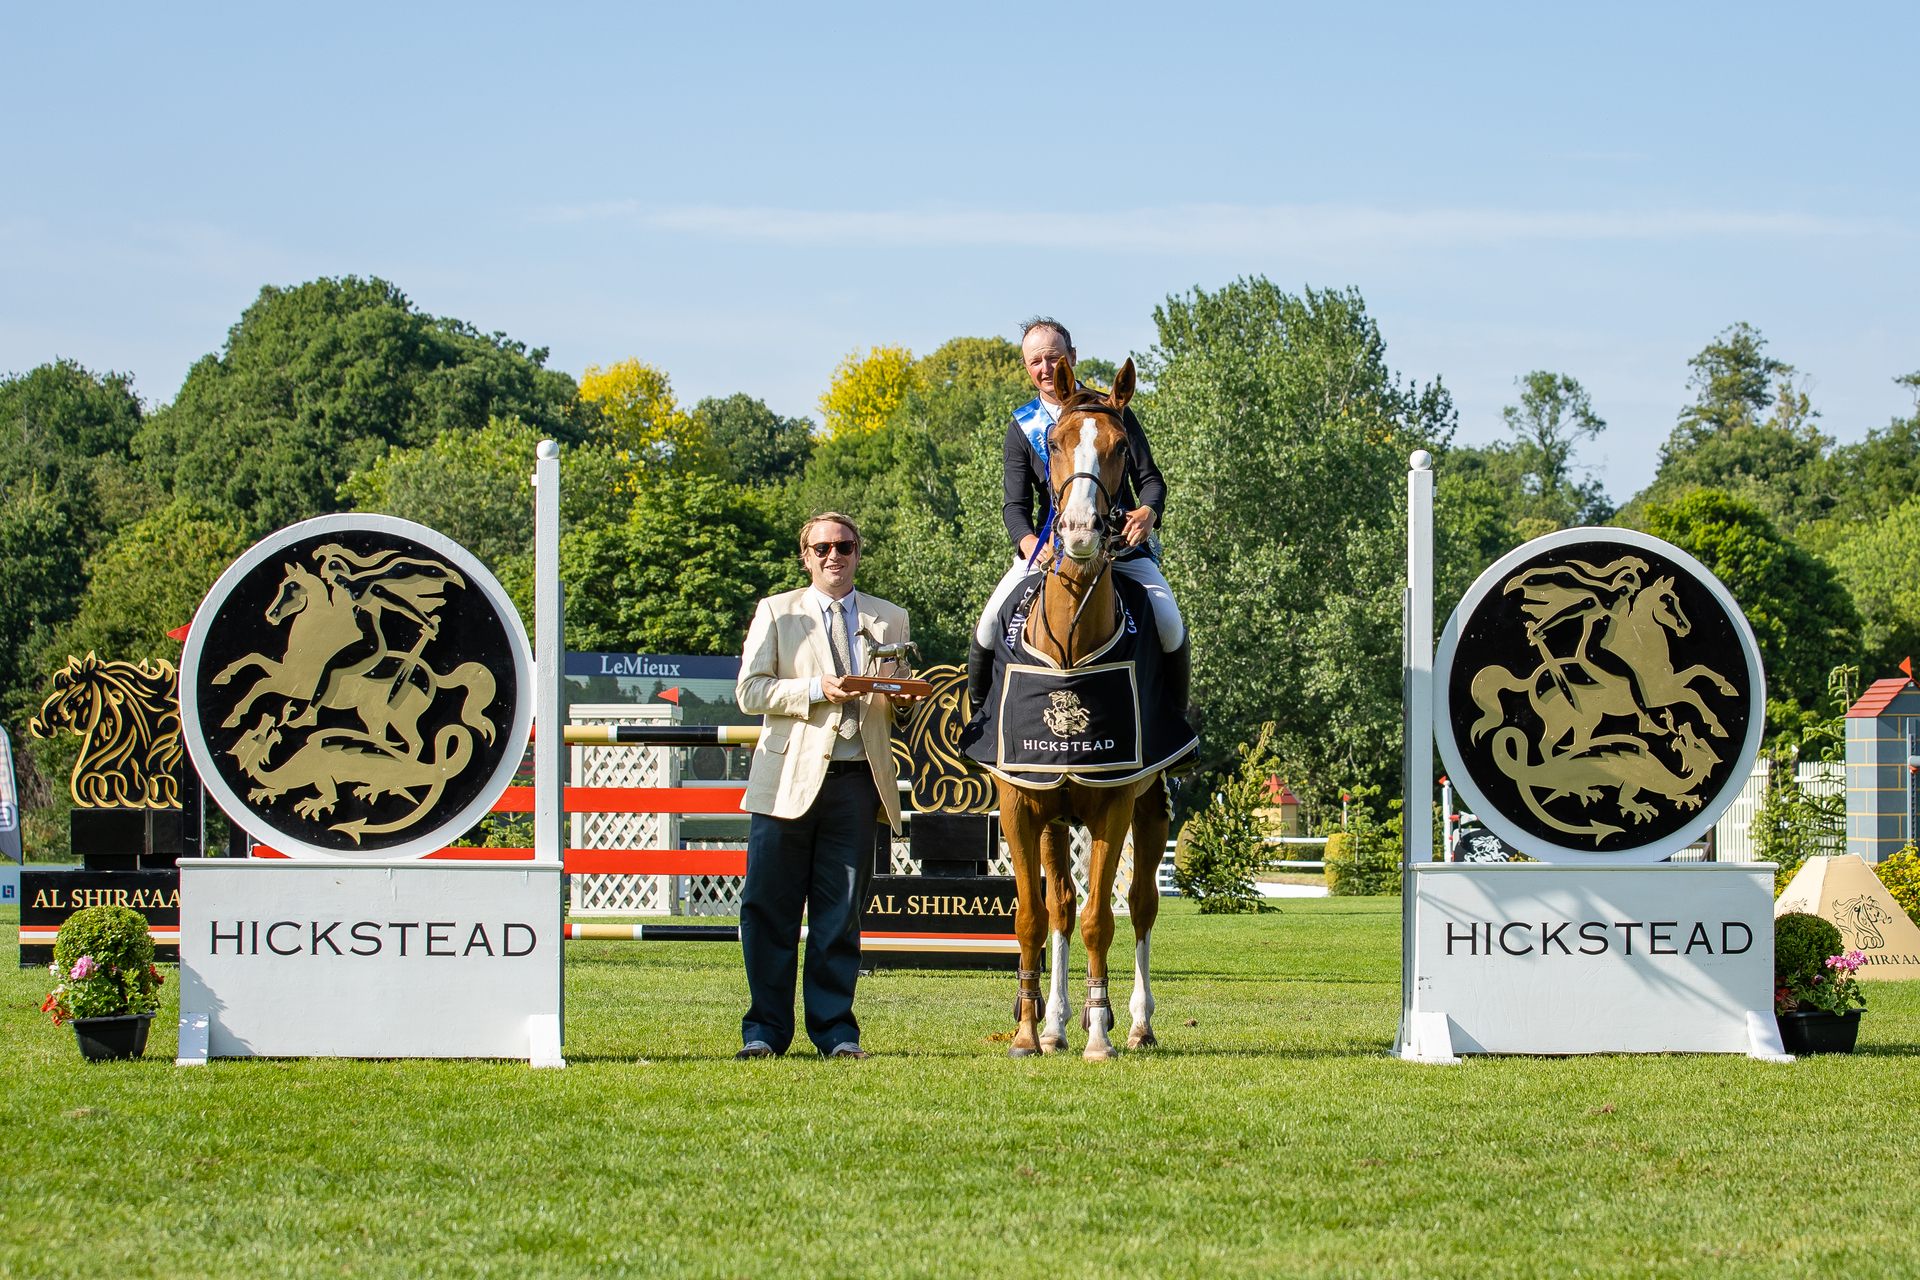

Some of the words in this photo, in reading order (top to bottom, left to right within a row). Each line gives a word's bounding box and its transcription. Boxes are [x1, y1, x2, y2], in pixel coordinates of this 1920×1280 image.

[600, 655, 680, 676] LeMieux
[1023, 739, 1115, 752] HICKSTEAD
[32, 888, 66, 908] AL
[866, 894, 901, 914] AL
[210, 920, 537, 956] HICKSTEAD
[1446, 921, 1753, 956] HICKSTEAD
